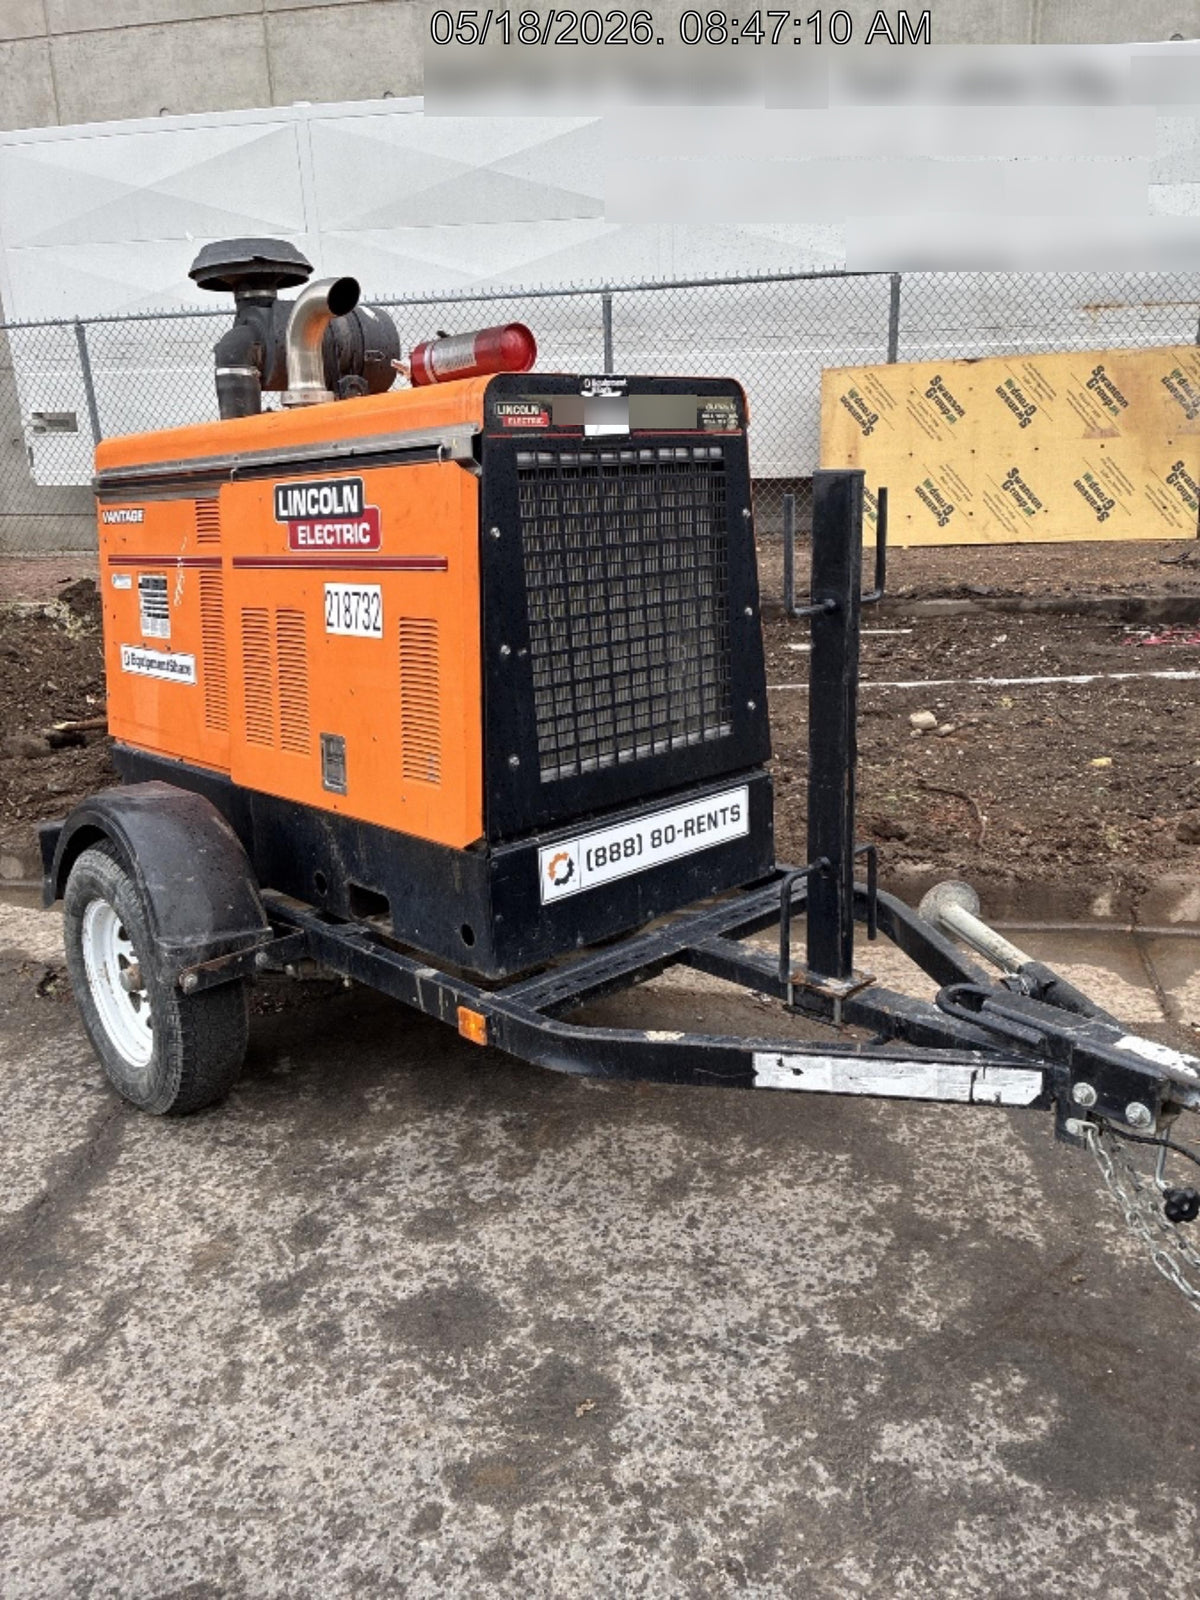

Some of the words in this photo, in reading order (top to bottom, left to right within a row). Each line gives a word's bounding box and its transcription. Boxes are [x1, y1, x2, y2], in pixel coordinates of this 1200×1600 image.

[924, 386, 951, 416] Group
[929, 374, 966, 418] Swanson
[1009, 387, 1038, 417] Group
[1085, 376, 1114, 406] Group
[1090, 364, 1130, 409] Swanson
[496, 404, 540, 415] LINCOLN
[840, 394, 874, 437] Swanson
[854, 397, 880, 426] Group
[994, 384, 1032, 429] Swanson
[1001, 479, 1027, 508] Group
[1006, 467, 1043, 511] Swanson
[1166, 472, 1194, 504] Group
[1171, 459, 1200, 499] Swans
[277, 484, 360, 517] LINCOLN
[914, 485, 951, 527] Swanson
[929, 486, 955, 517] Group
[1073, 478, 1111, 523] Swanson
[1088, 480, 1116, 512] Group
[102, 509, 145, 524] VANTAGE
[296, 522, 371, 546] ELECTRIC
[325, 590, 381, 632] 218732
[585, 833, 643, 871] (888)
[650, 804, 741, 849] 80-RENTS
